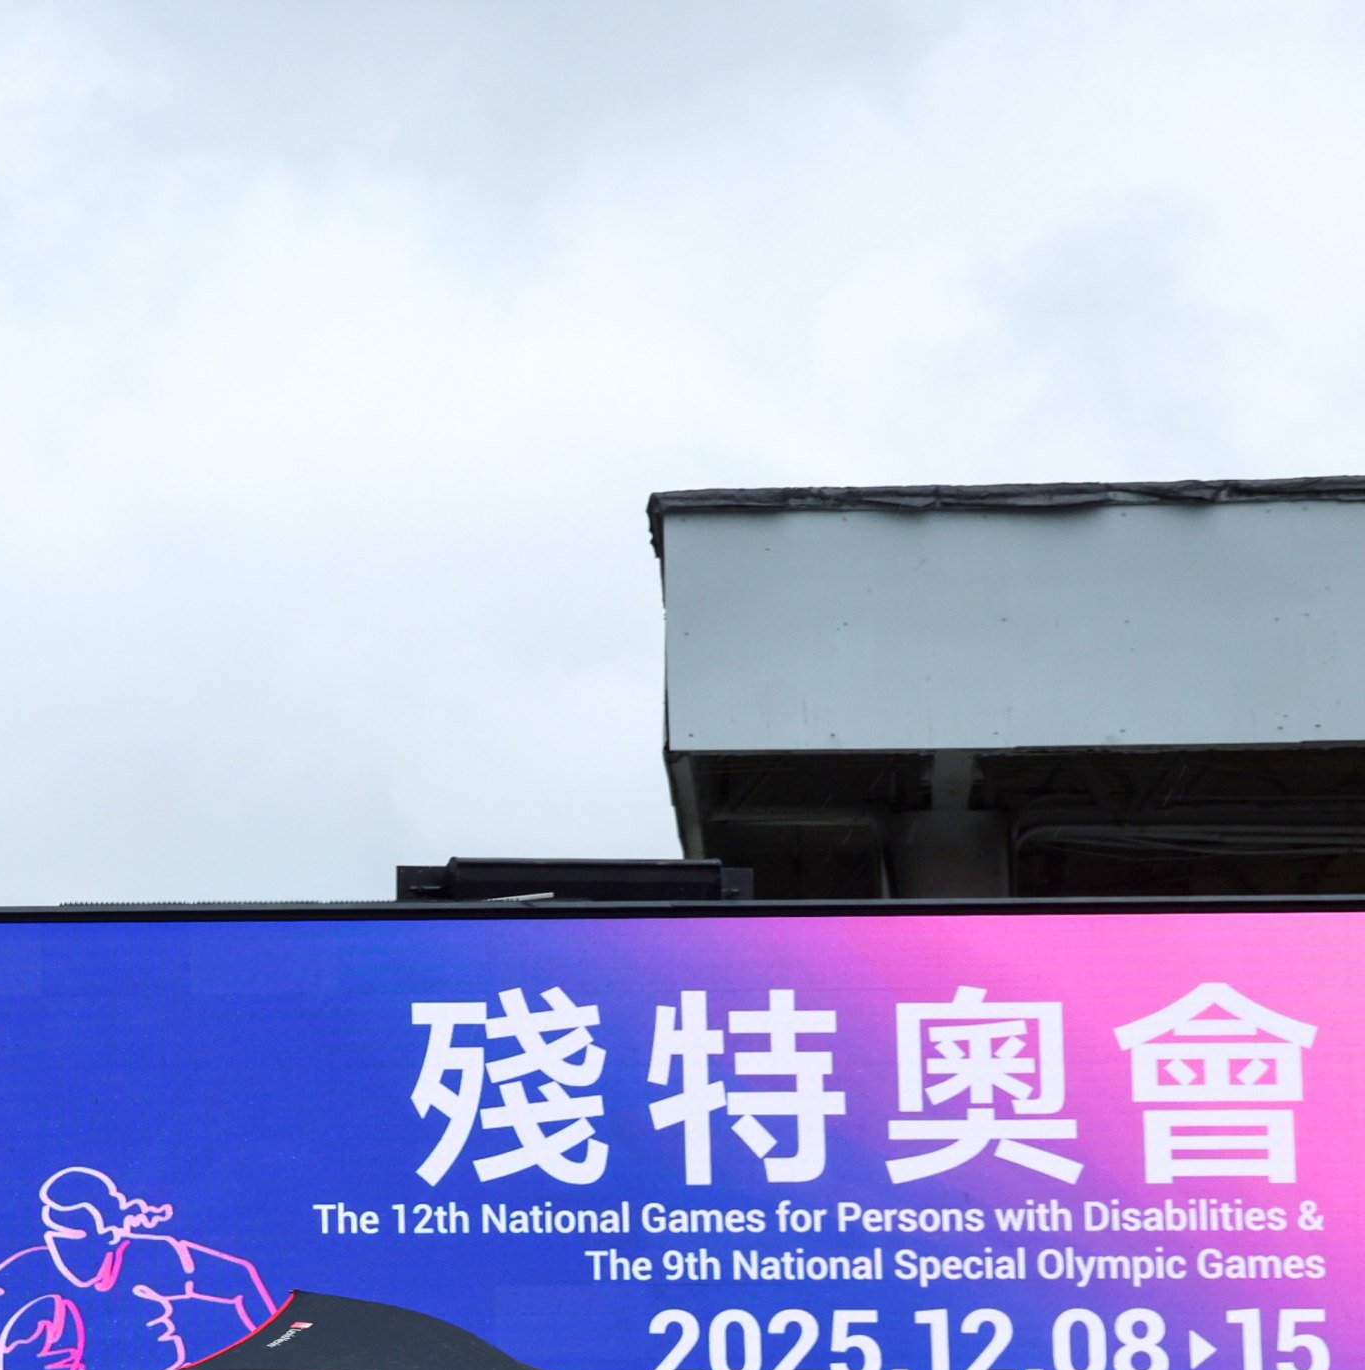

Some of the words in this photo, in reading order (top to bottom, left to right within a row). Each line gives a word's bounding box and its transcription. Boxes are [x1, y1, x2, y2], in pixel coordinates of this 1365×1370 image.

[411, 982, 1318, 1187] 殘特奧會
[313, 1202, 379, 1234] The
[392, 1202, 469, 1234] 12th
[482, 1201, 630, 1234] National
[642, 1202, 766, 1233] Games
[776, 1200, 826, 1233] for
[838, 1202, 985, 1233] Persons
[995, 1199, 1072, 1232] with
[1084, 1199, 1288, 1232] Disabilities
[1298, 1200, 1325, 1231] &
[585, 1249, 653, 1281] The
[663, 1248, 721, 1281] 9th
[733, 1247, 883, 1280] National
[895, 1247, 1027, 1288] Special
[1038, 1247, 1187, 1288] Olympic
[1197, 1248, 1327, 1280] Games
